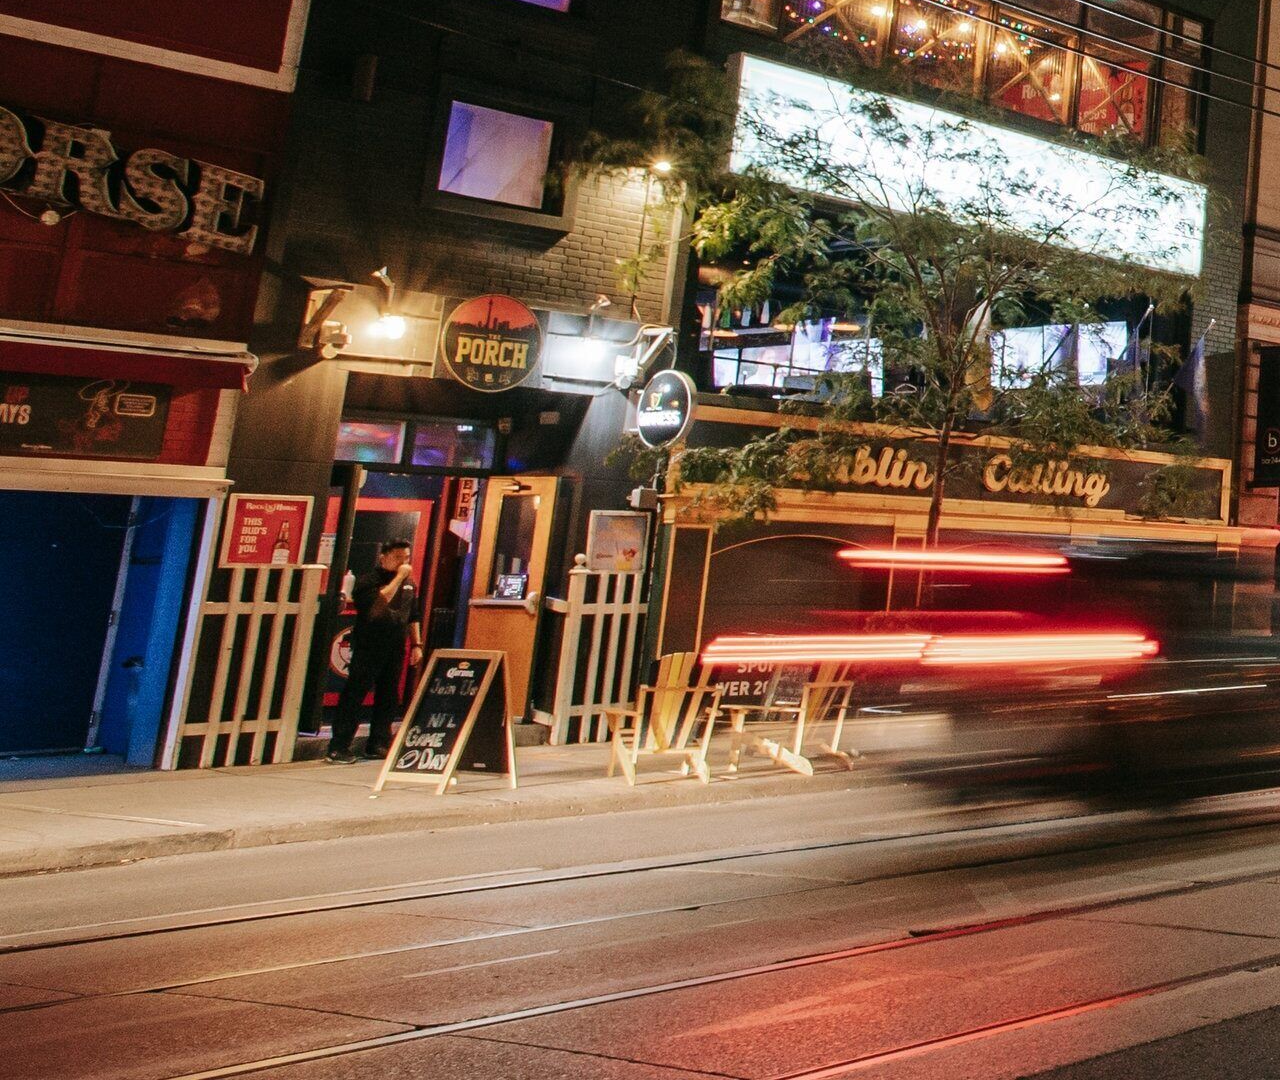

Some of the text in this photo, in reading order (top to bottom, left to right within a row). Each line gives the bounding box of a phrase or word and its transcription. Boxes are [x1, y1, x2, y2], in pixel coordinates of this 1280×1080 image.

[455, 336, 529, 369] PORCH
[243, 517, 263, 526] THIS
[241, 526, 268, 535] BUD'S
[240, 535, 257, 543] FOR
[712, 681, 750, 697] VER
[427, 713, 456, 728] NFL
